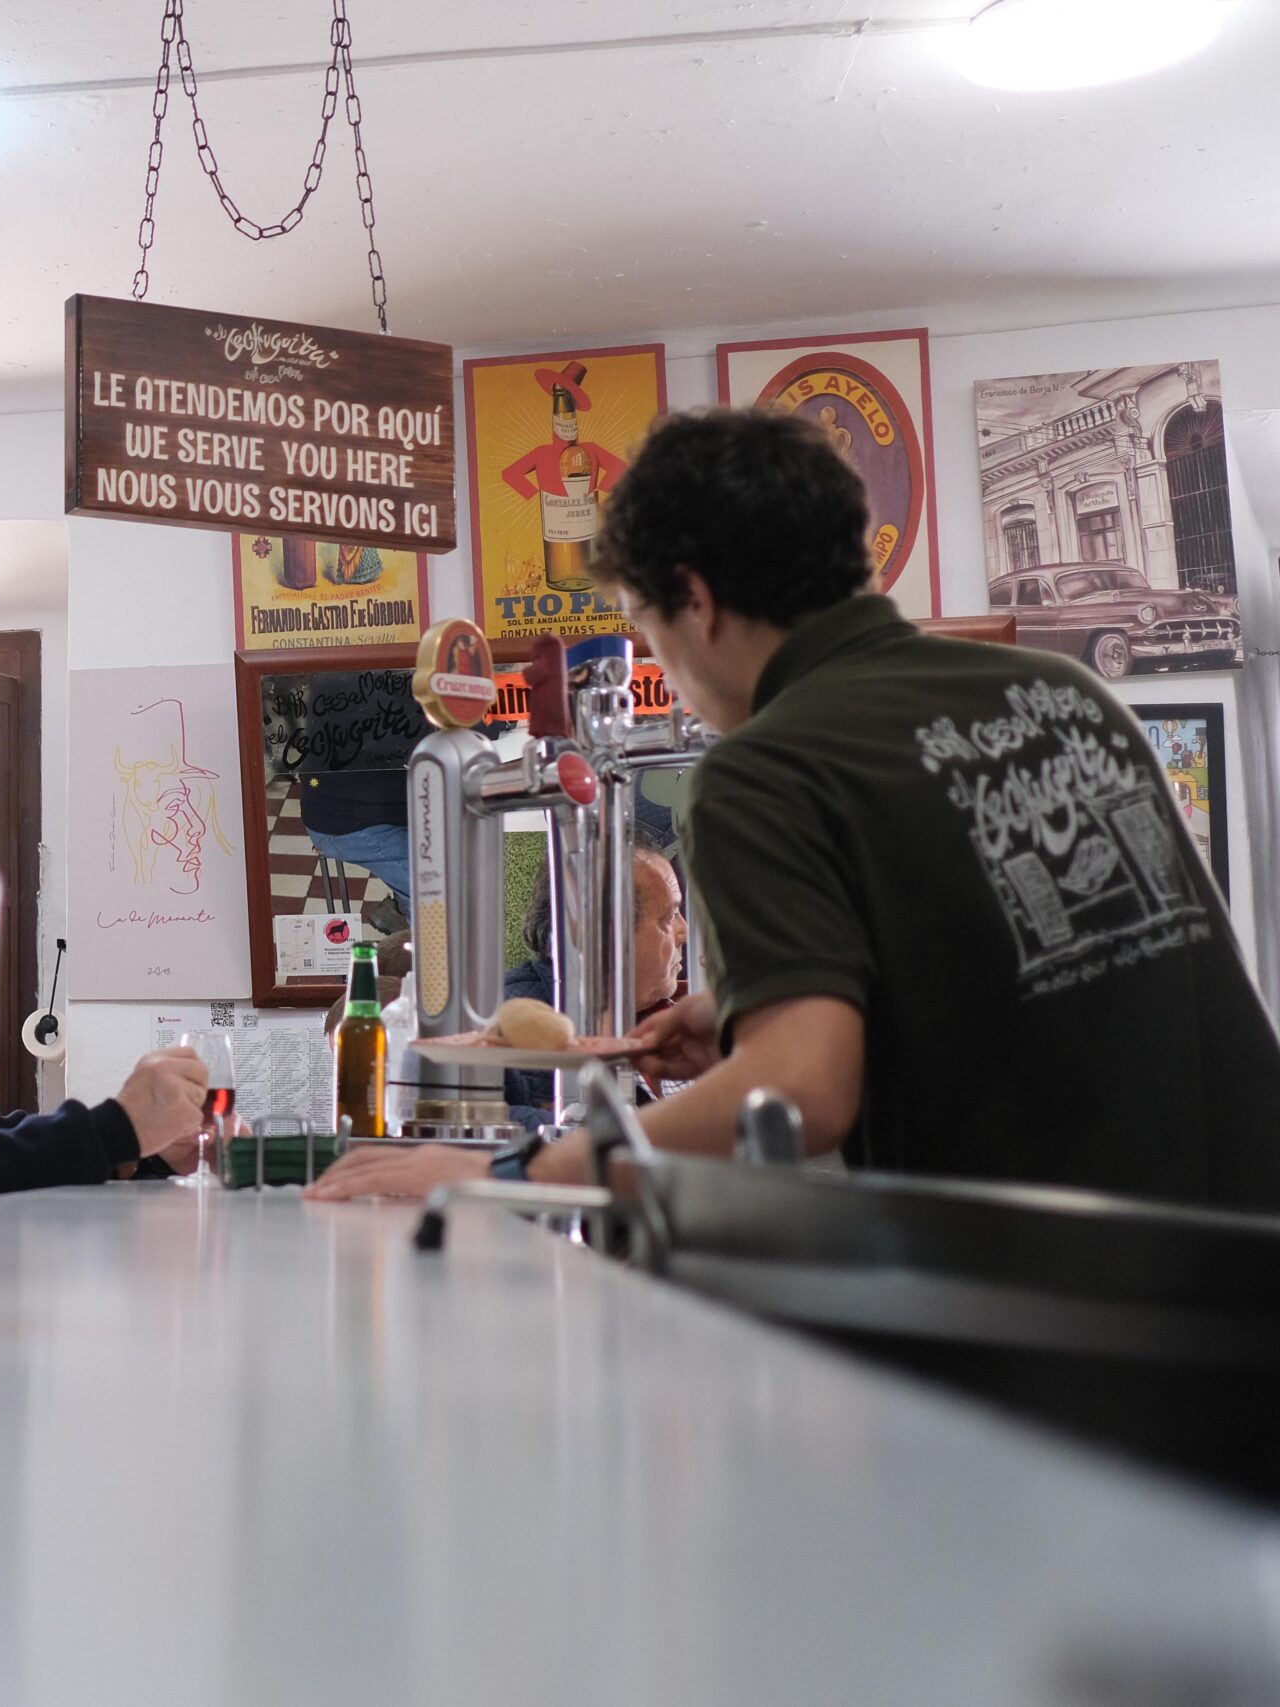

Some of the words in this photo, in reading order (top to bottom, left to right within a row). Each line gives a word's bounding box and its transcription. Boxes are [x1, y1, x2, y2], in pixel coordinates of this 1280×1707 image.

[1019, 387, 1028, 395] de
[1030, 385, 1052, 396] Borja
[93, 371, 126, 408] LE
[135, 376, 306, 430] ATENDEMOS
[314, 398, 370, 438] POR
[378, 404, 443, 450] AQUÍ
[823, 375, 891, 439] AYELO
[125, 422, 169, 460] WE
[177, 428, 265, 472] SERVE
[281, 439, 337, 481] YOU
[346, 448, 415, 489] HERE
[97, 467, 177, 510] NOUS
[185, 477, 262, 519] VOUS
[269, 485, 397, 535] SERVONS
[404, 501, 439, 539] ICI
[250, 605, 302, 634] FERNANDO
[302, 612, 311, 631] DE
[311, 602, 349, 631] CASTRO
[367, 599, 415, 627] CÓRDOBA
[495, 594, 563, 619] TIO
[507, 618, 522, 626] SOL
[537, 616, 582, 625] ANDALUCIA
[559, 625, 595, 635] BYASS
[273, 636, 351, 649] CONSTANTINA
[436, 677, 494, 697] Cruzcampo
